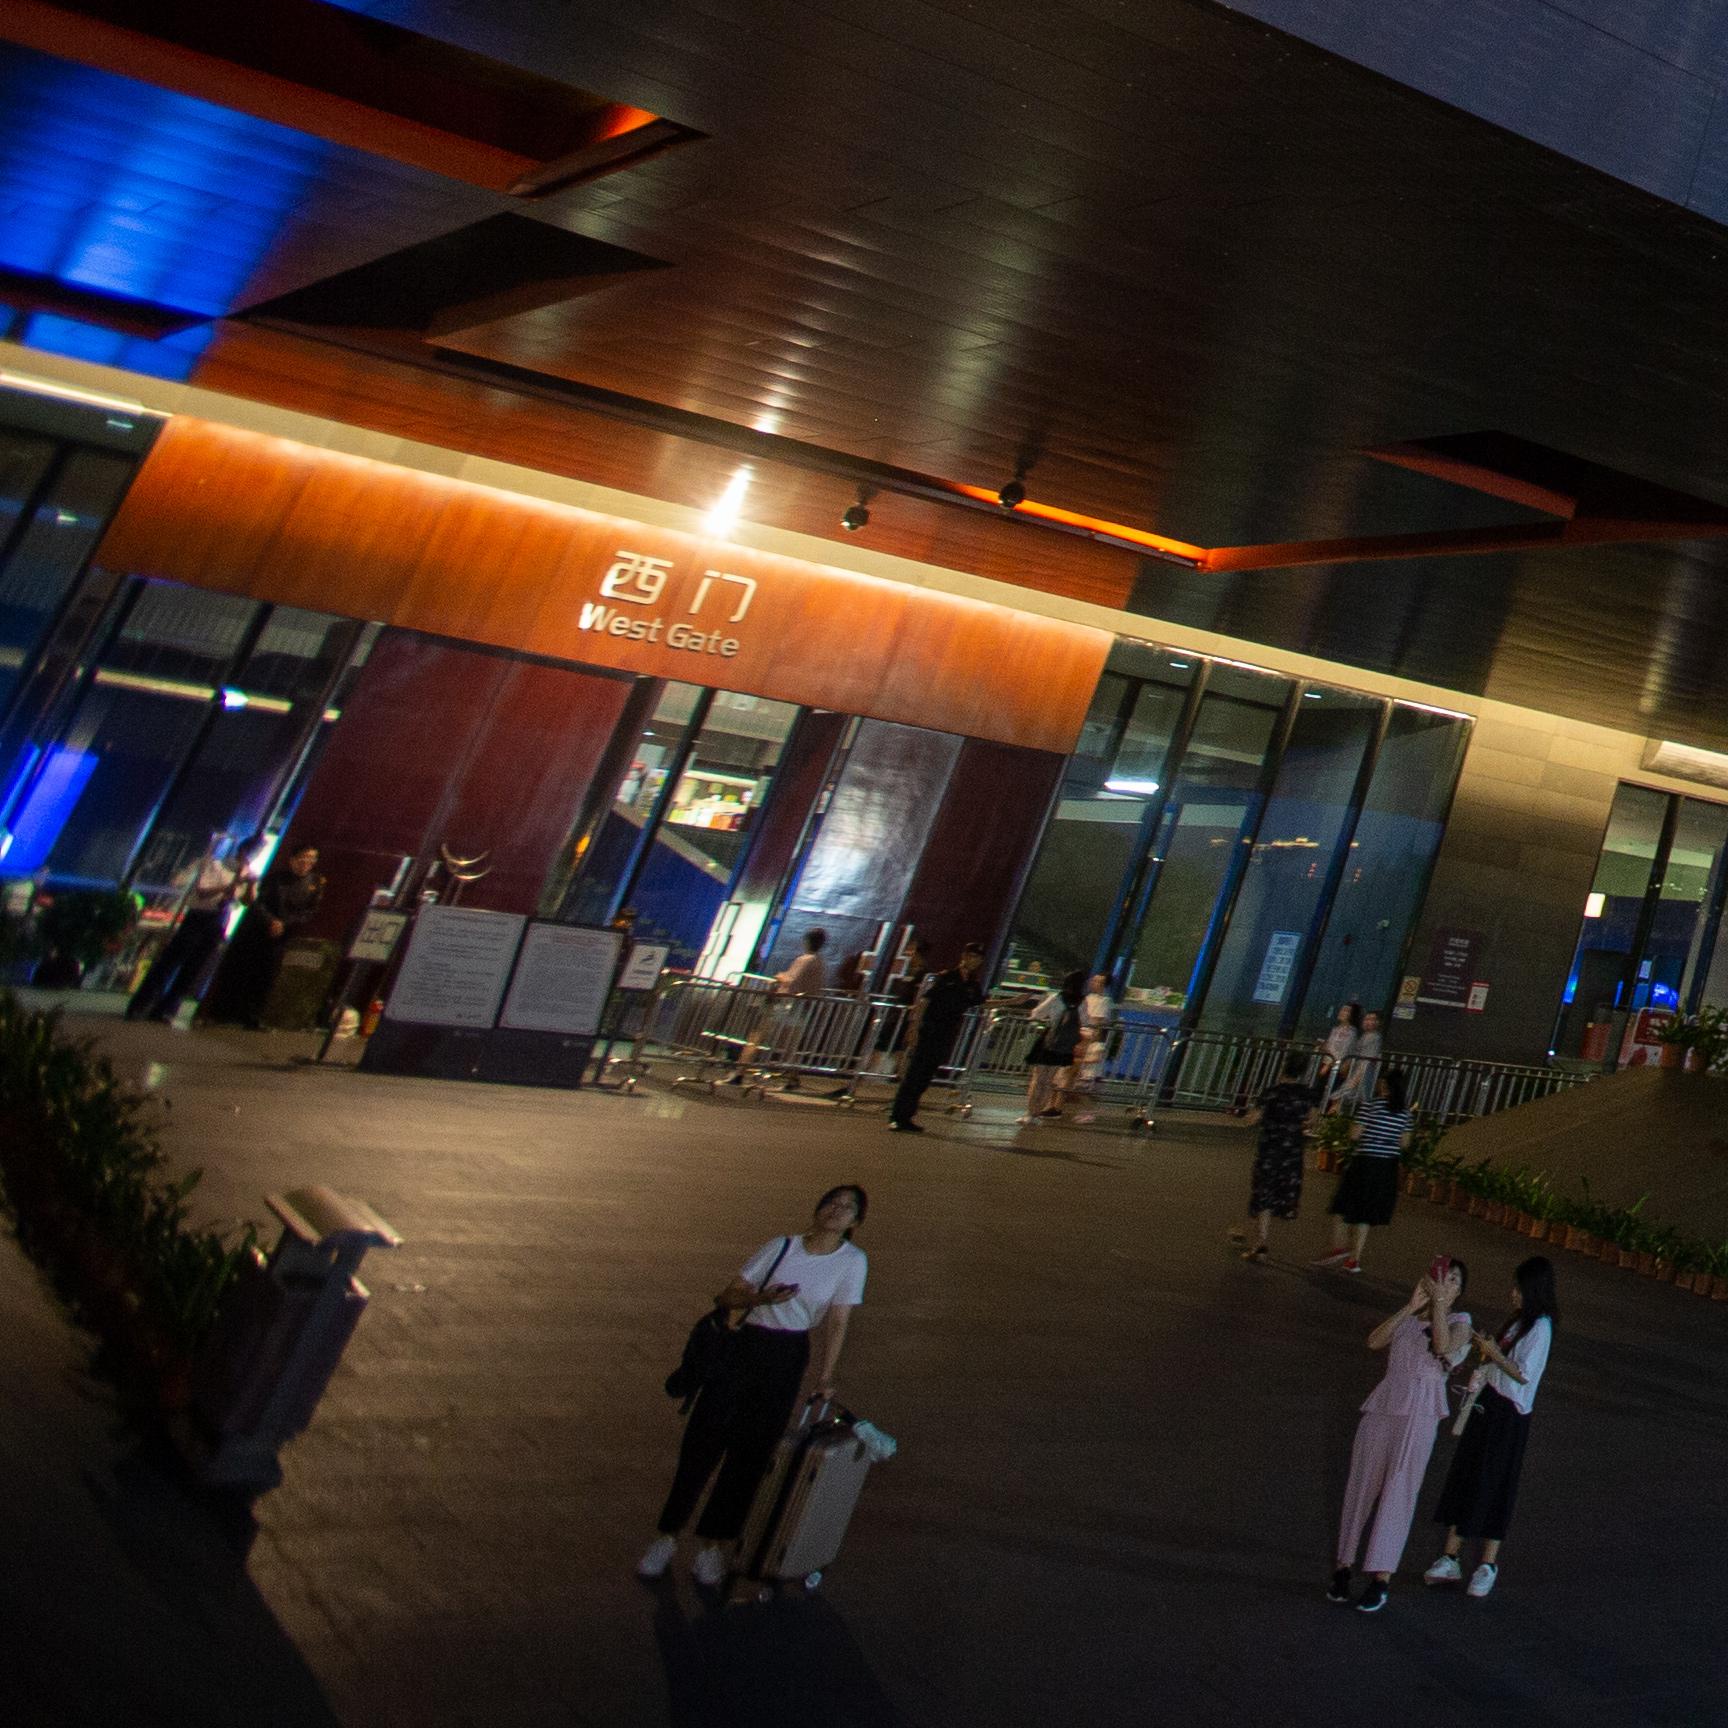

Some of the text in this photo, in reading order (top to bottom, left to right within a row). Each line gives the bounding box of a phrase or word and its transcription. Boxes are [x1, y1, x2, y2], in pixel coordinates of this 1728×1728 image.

[599, 550, 758, 623] 西门
[577, 602, 741, 657] West Gate
